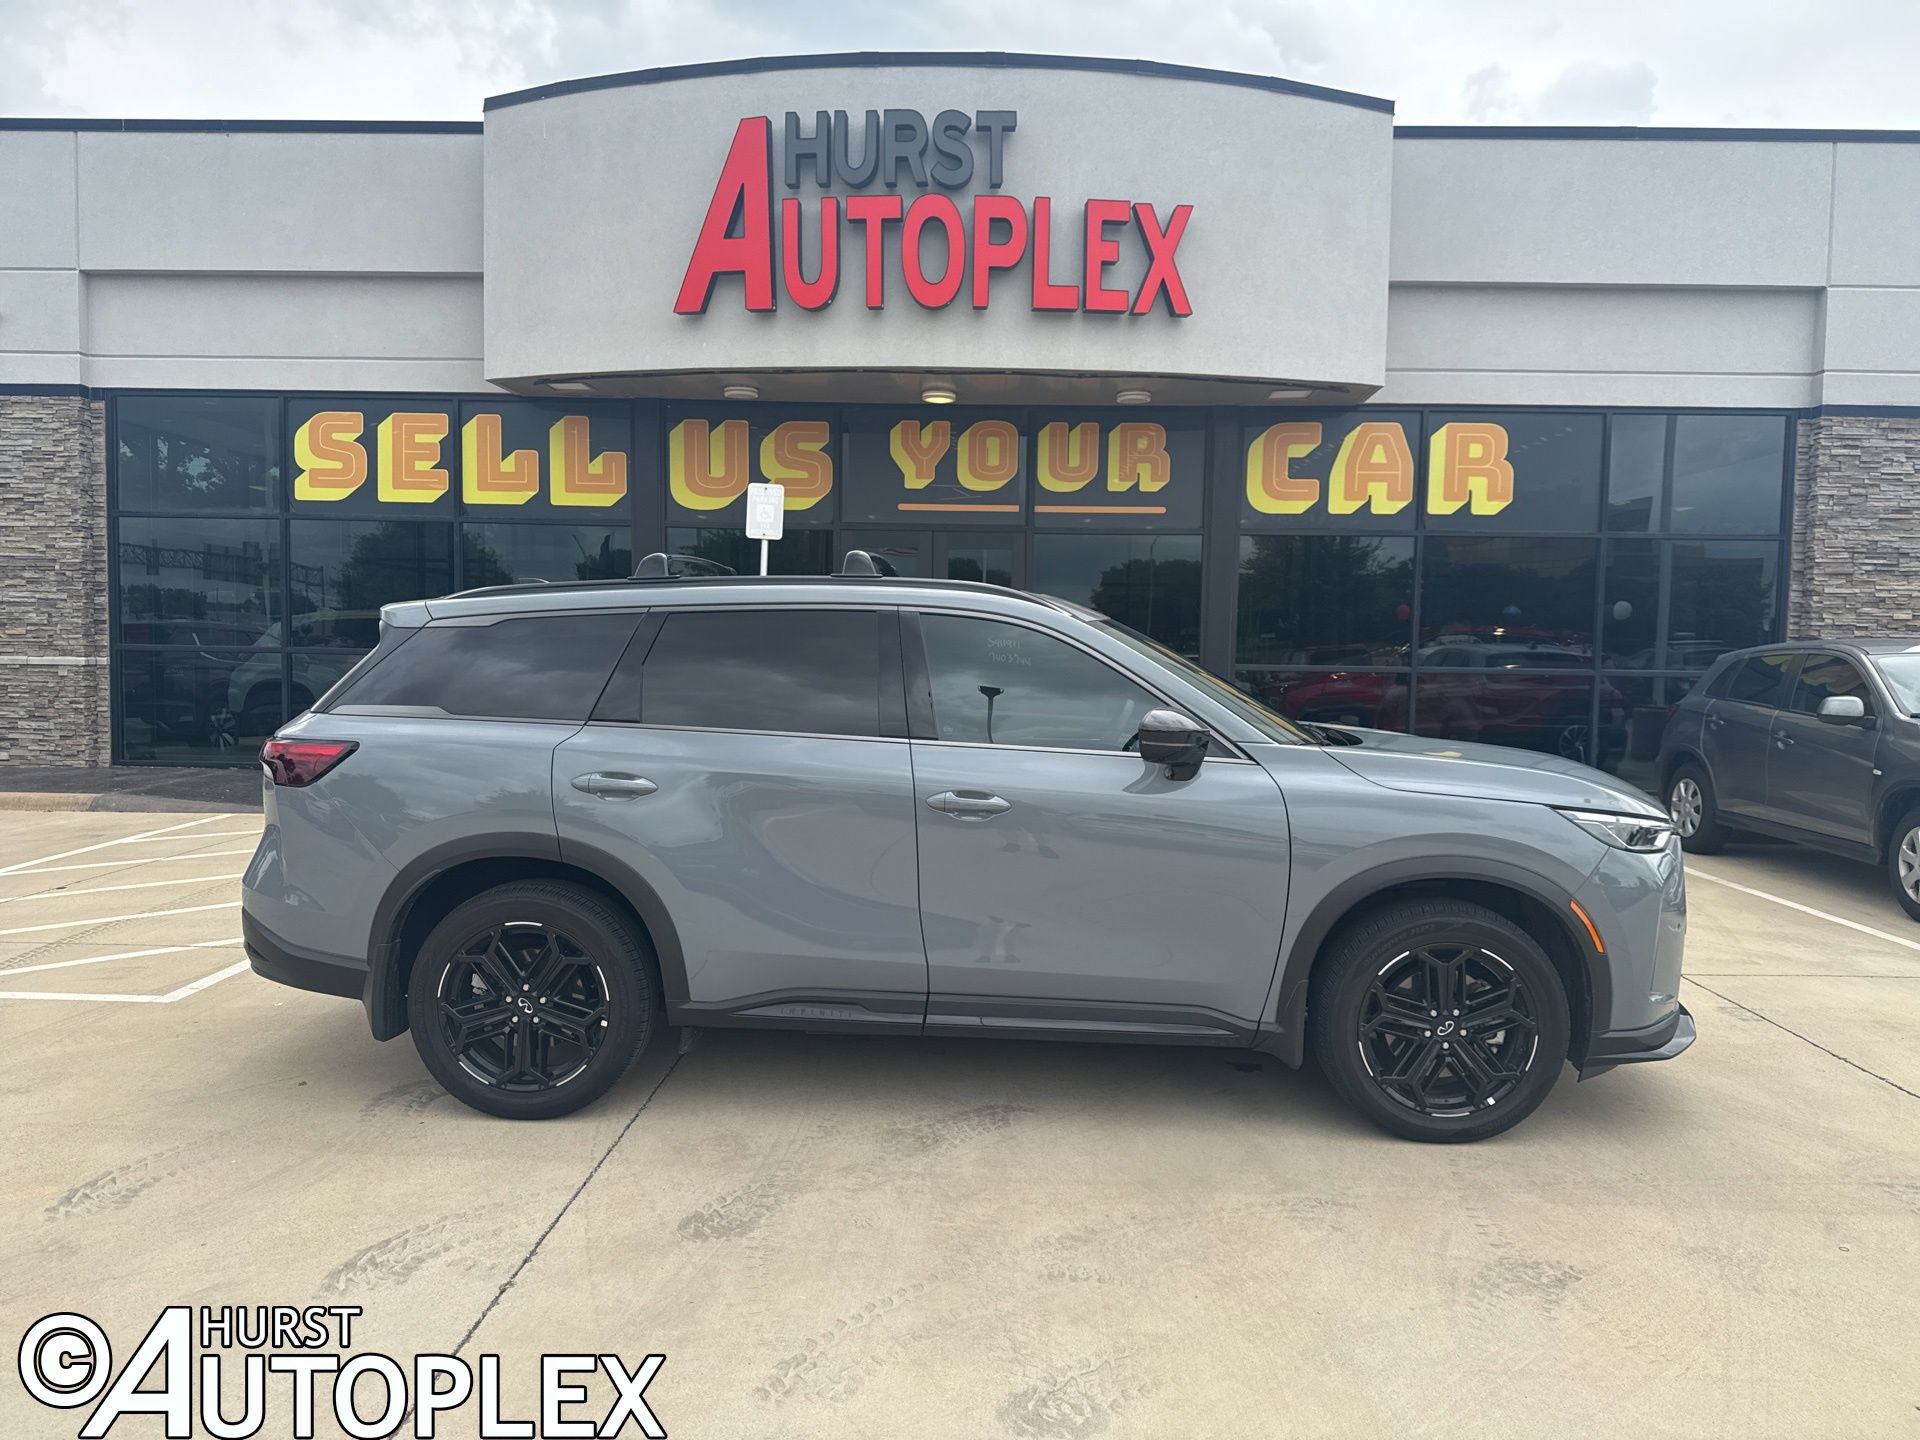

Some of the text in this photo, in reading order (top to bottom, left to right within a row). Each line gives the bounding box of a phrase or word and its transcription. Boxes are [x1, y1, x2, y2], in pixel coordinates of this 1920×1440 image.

[784, 109, 1018, 190] HURST
[673, 115, 1195, 318] AUTOPLEX
[293, 411, 1514, 516] SELL US YOUR CAR
